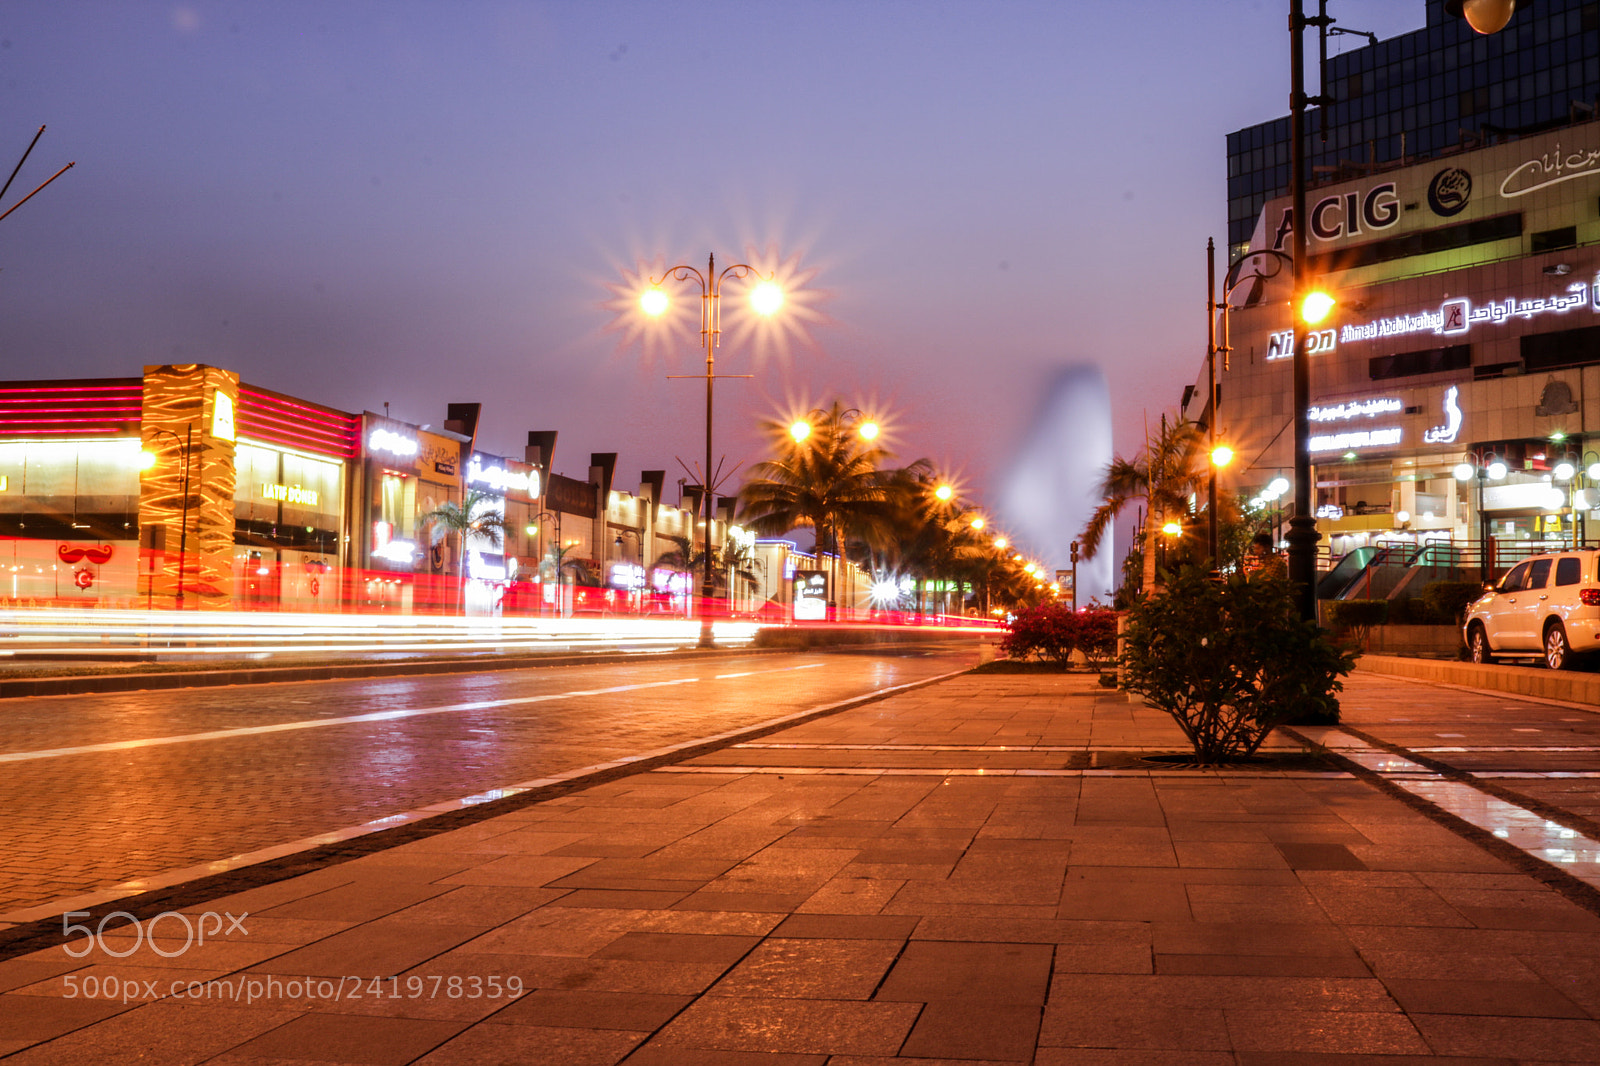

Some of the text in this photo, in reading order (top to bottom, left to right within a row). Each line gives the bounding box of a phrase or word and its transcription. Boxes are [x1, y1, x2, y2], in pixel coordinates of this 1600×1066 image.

[1272, 182, 1401, 252] ACIG
[1468, 298, 1515, 323] الواحد
[1265, 329, 1337, 361] Nion
[1340, 320, 1378, 343] Ahmed
